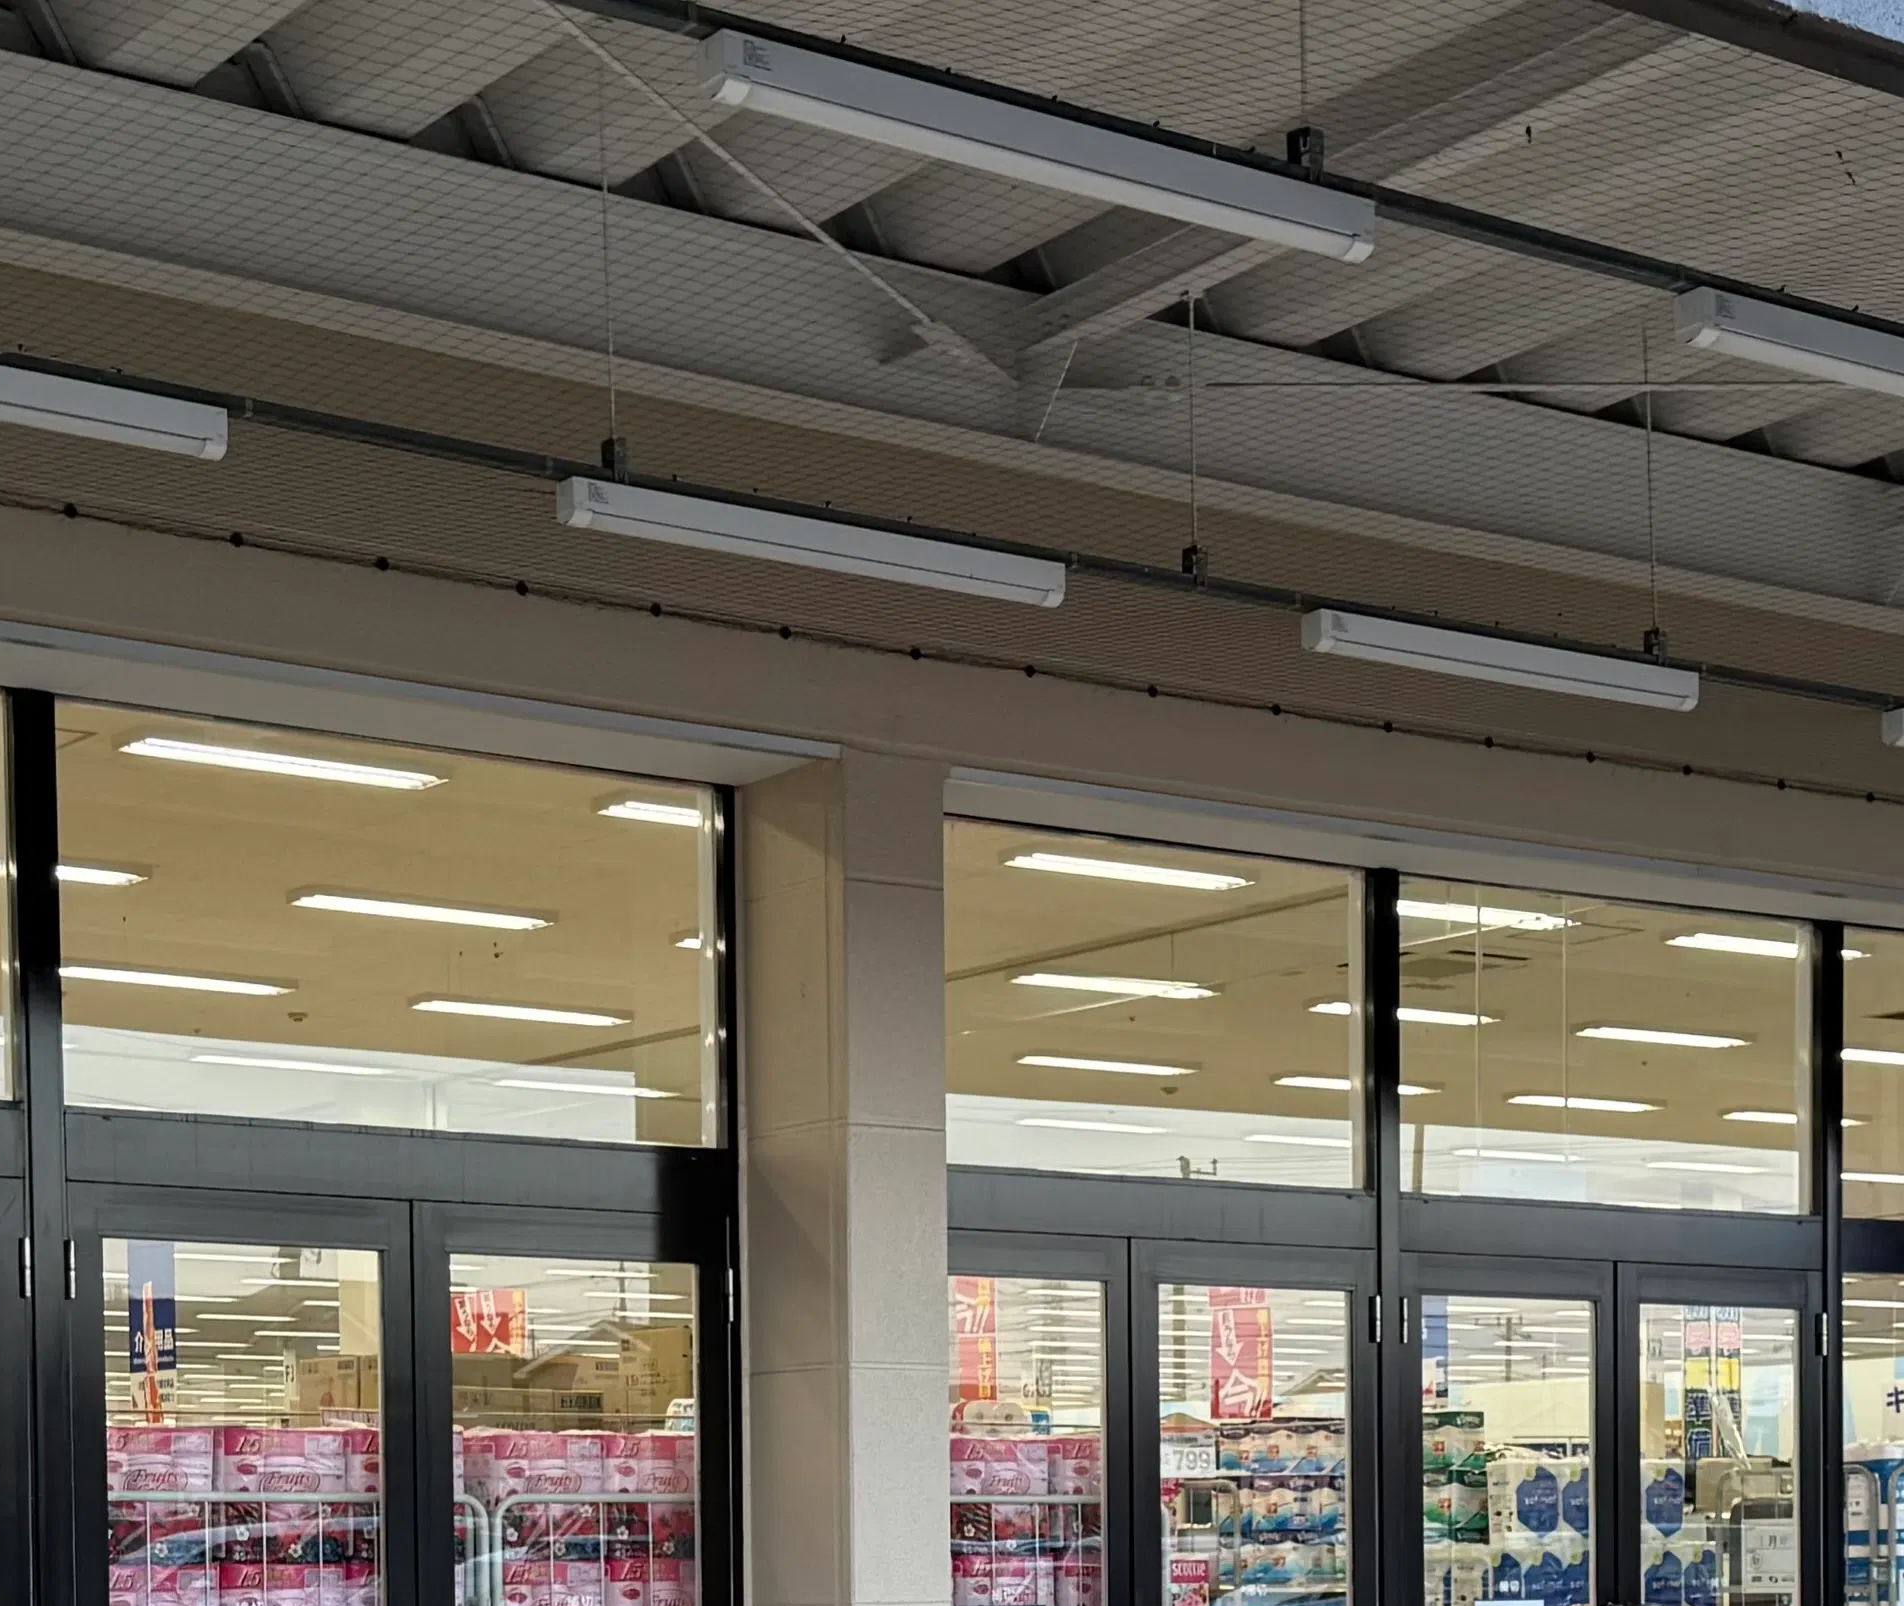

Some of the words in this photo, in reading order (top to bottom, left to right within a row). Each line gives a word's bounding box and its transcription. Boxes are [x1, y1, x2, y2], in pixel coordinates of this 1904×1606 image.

[133, 1327, 174, 1353] 介用品
[234, 1432, 262, 1451] 1.5
[1173, 1451, 1213, 1471] 799
[131, 1469, 179, 1484] Fruits
[265, 1471, 313, 1486] Fruits
[238, 1570, 262, 1588] 1.5
